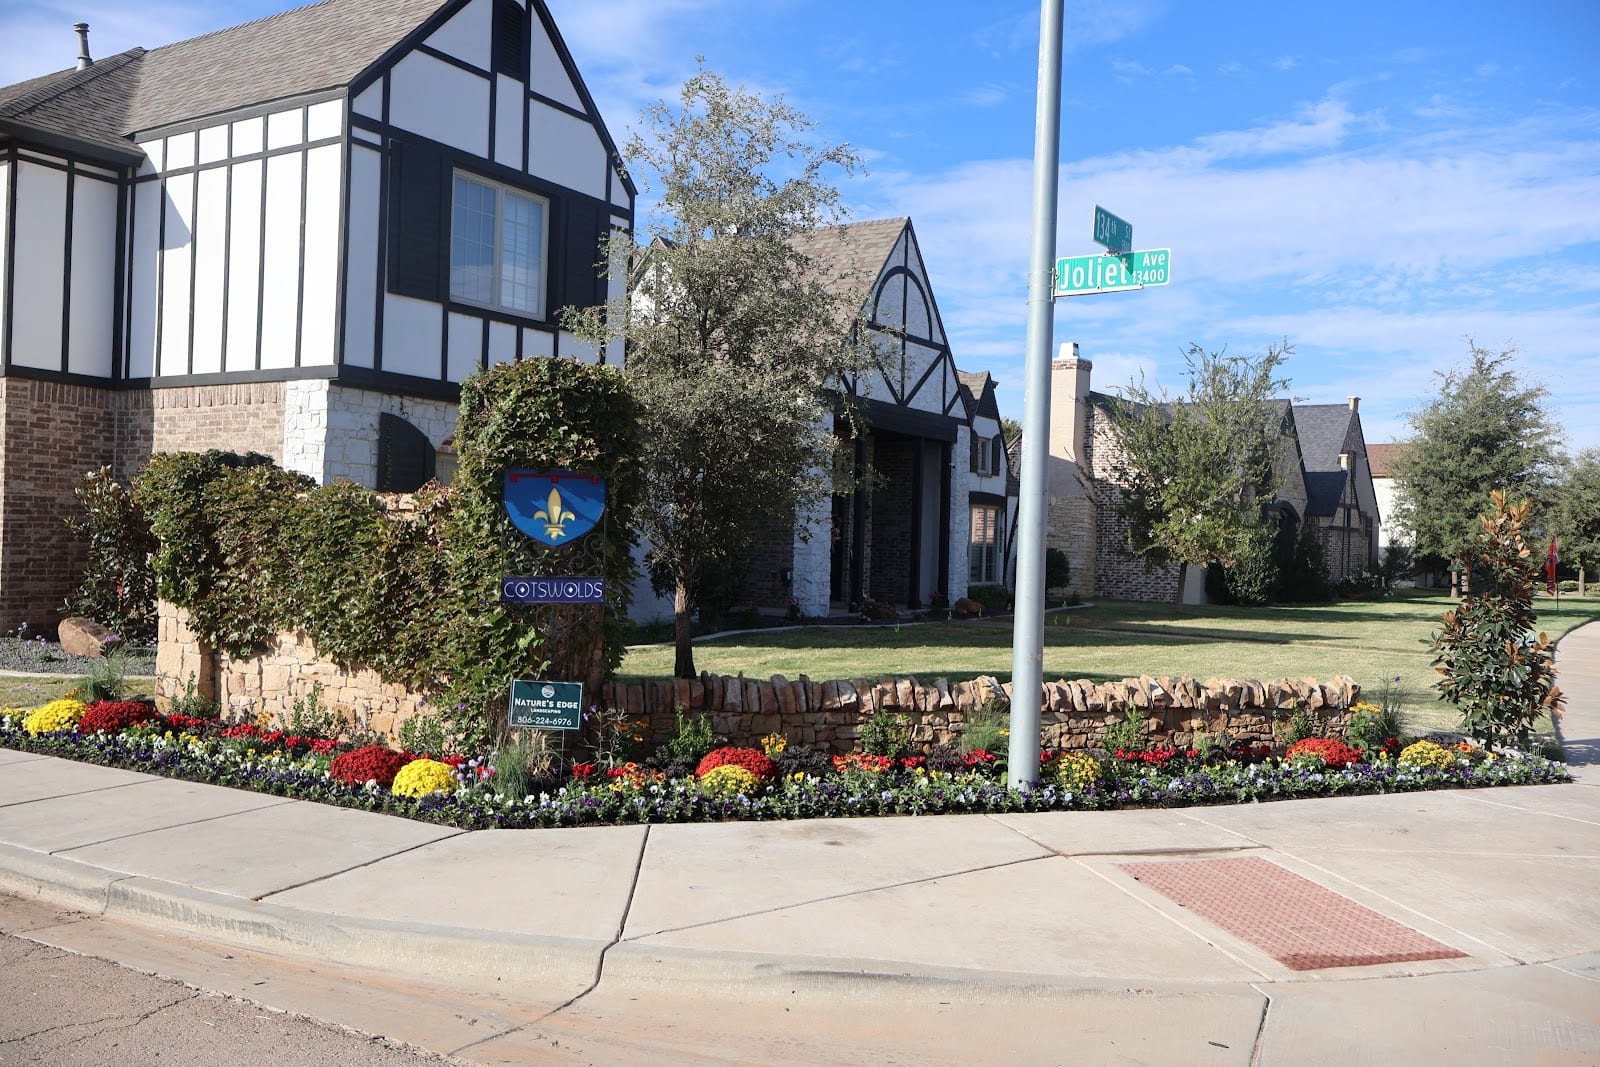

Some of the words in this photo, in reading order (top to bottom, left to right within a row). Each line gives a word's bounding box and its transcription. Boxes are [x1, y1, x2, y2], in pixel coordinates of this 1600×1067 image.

[1061, 257, 1128, 289] Joliet
[1142, 252, 1166, 267] Ave
[1132, 268, 1165, 284] 13400
[503, 581, 603, 598] COTSWOLDS
[514, 698, 554, 708] NATURE'S
[556, 701, 579, 709] EDGE
[517, 716, 572, 726] 806-224-6976
